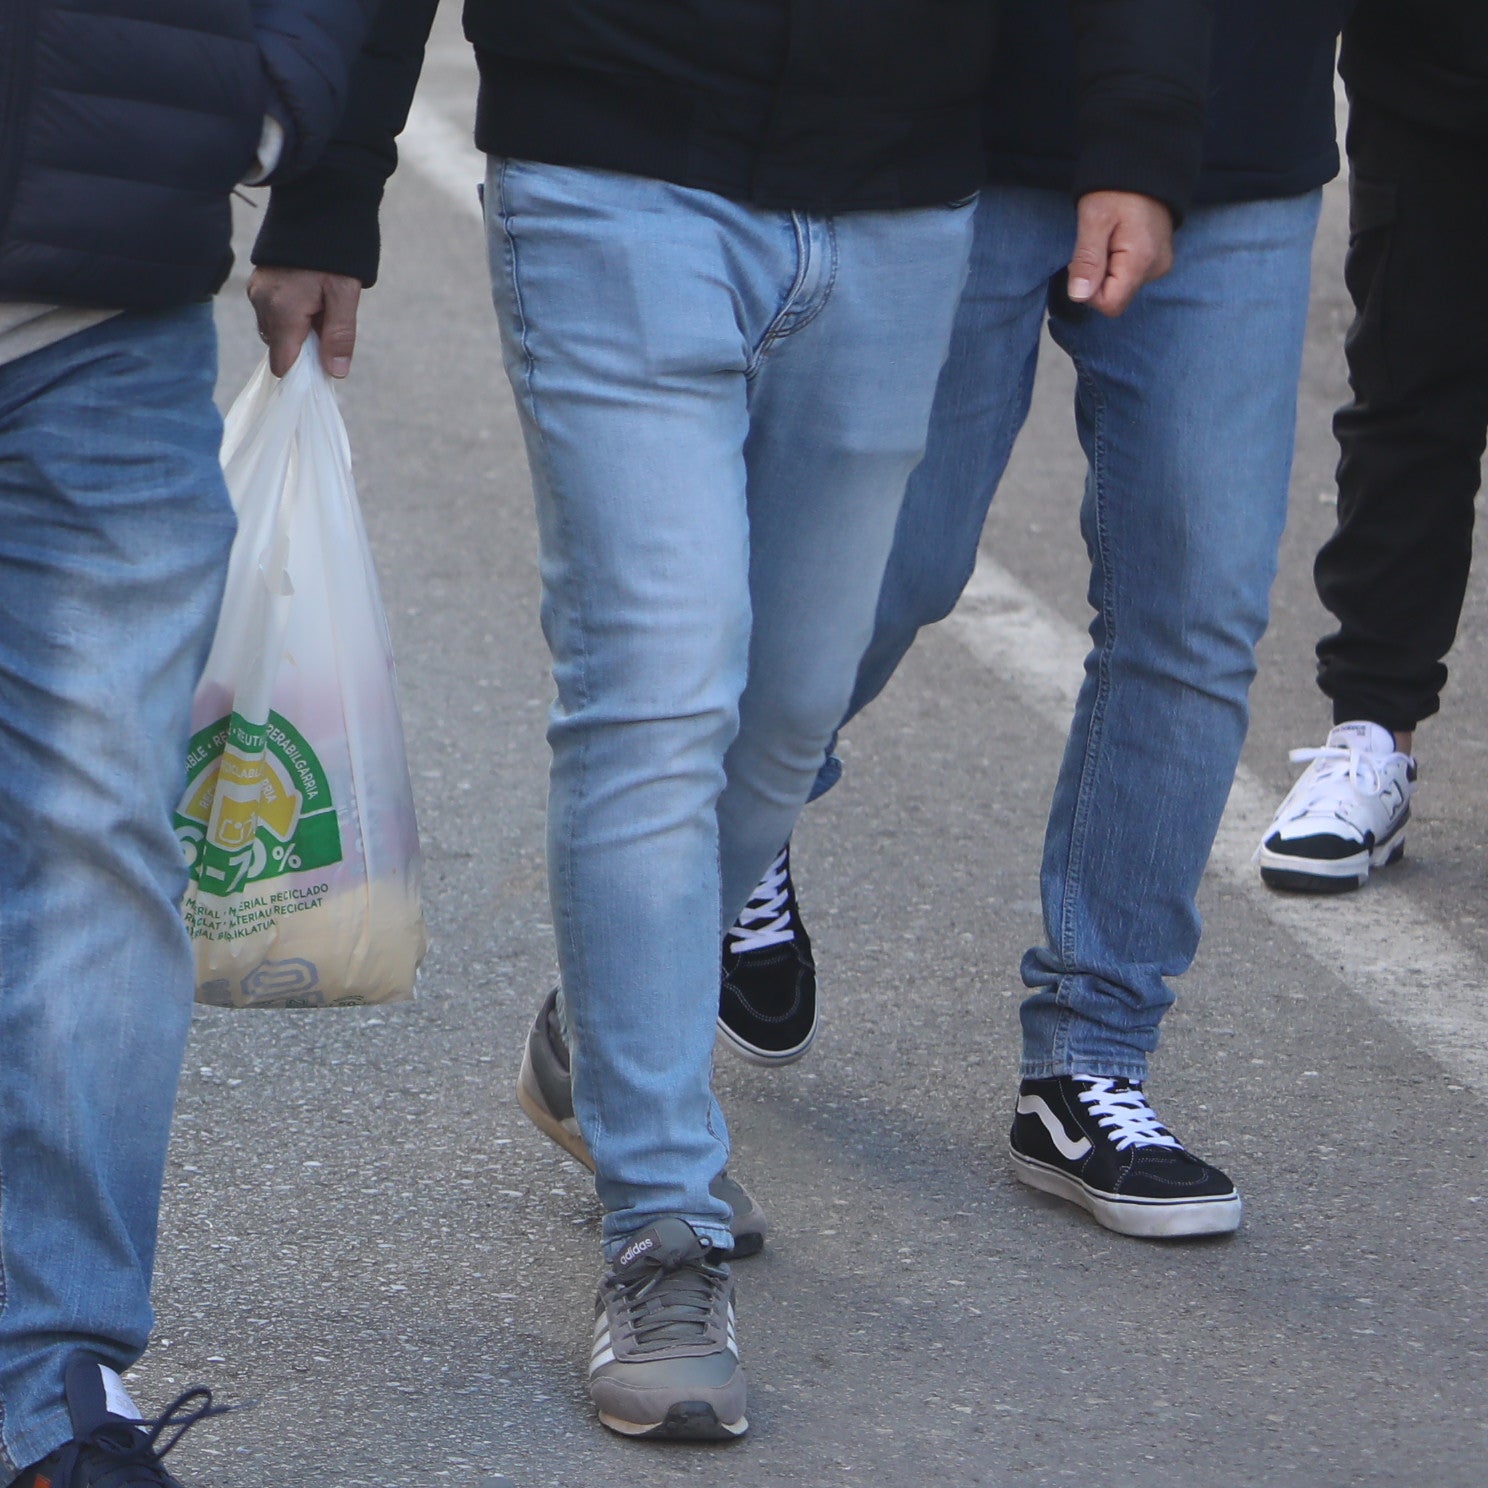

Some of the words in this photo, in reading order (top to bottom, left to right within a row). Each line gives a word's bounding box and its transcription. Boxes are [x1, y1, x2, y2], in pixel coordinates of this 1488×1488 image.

[270, 883, 329, 903] RECICLADO
[273, 898, 324, 915] RECICLAT
[620, 1238, 653, 1265] adidas
